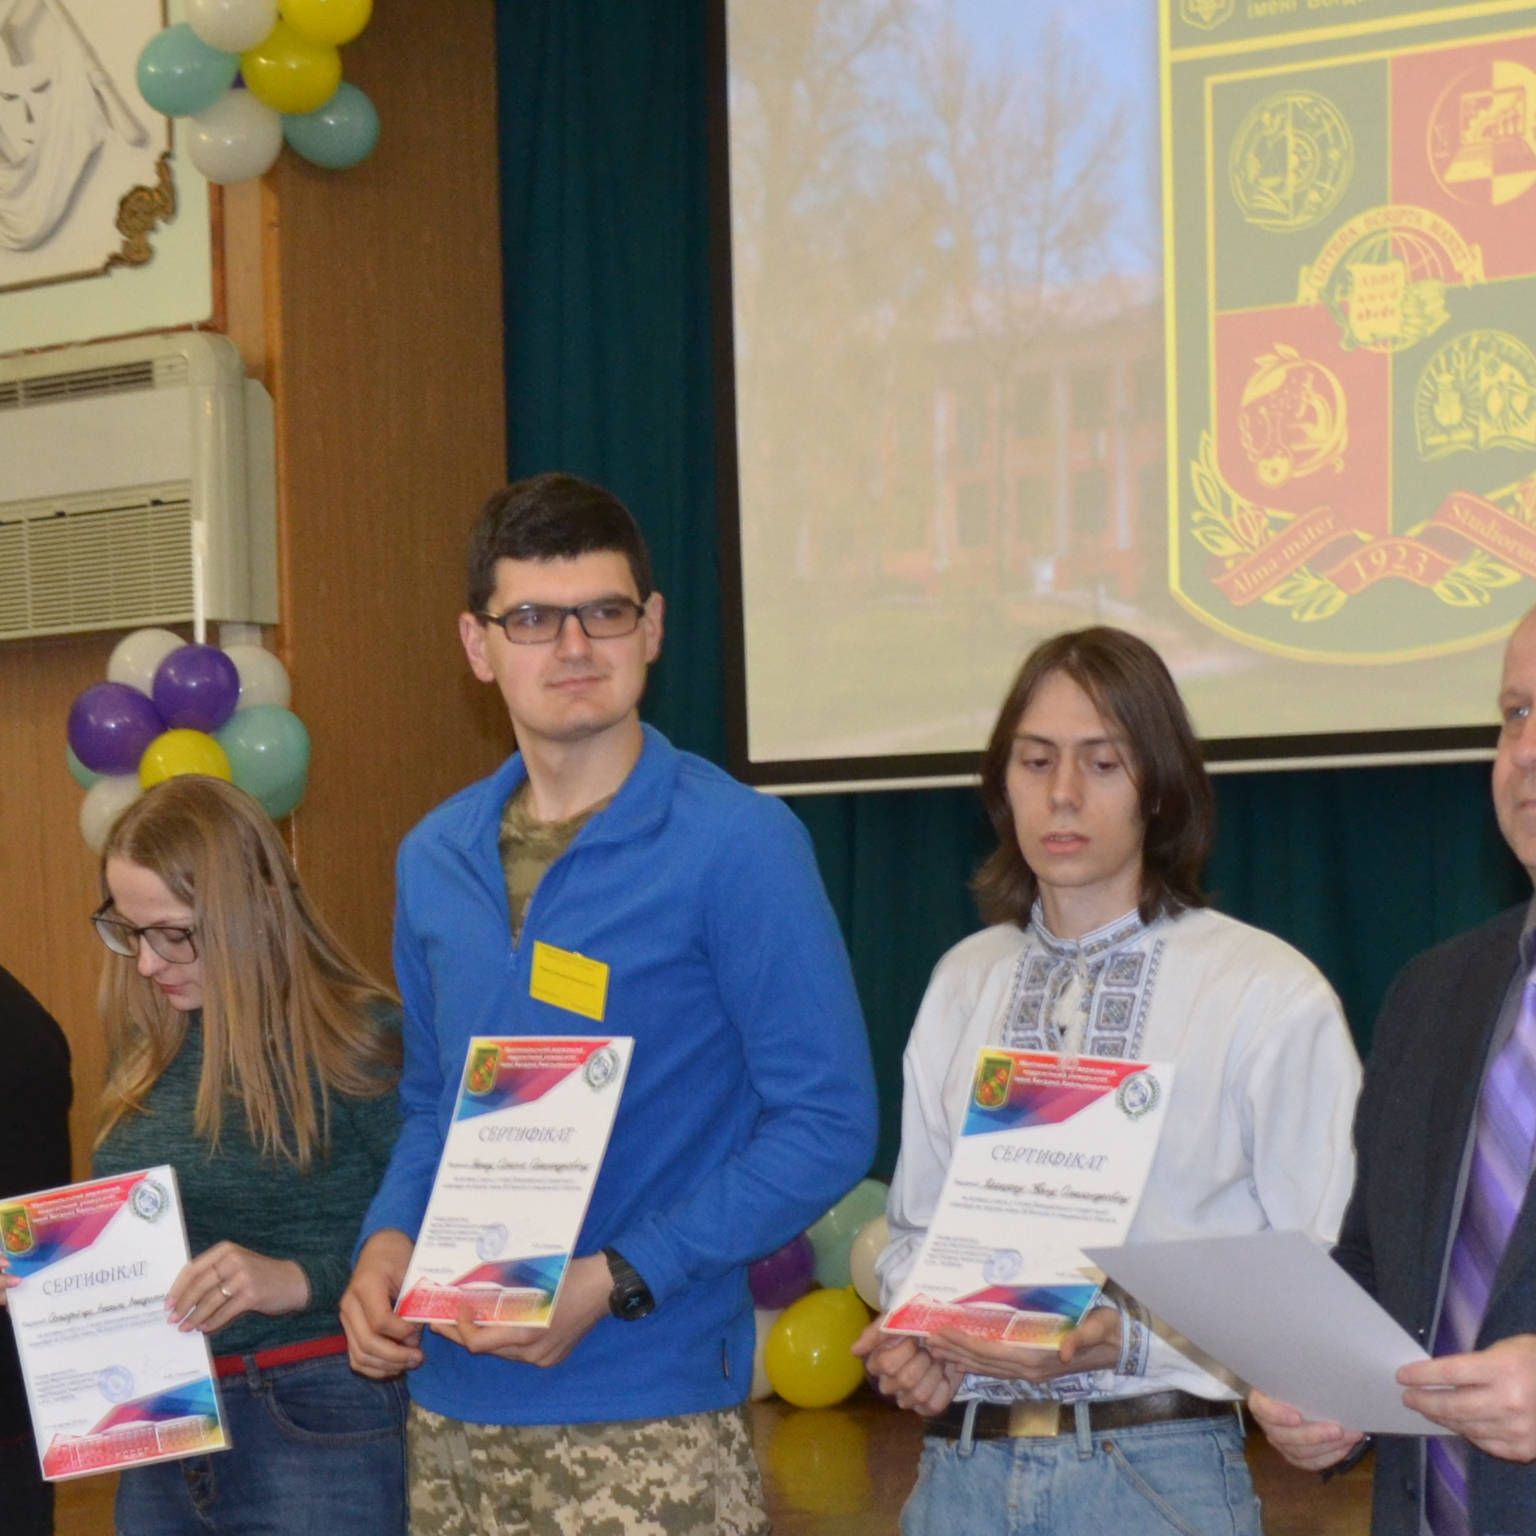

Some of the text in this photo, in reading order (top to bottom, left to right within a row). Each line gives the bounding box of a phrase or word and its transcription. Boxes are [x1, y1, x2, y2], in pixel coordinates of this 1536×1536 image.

[1233, 516, 1334, 594] Alma mater
[1353, 545, 1430, 582] 1923
[478, 1126, 576, 1144] СЕРТИФІКАТ
[991, 1144, 1109, 1172] СЕРТИФІКАТ
[42, 1259, 148, 1296] СЕРТИФІКАТ
